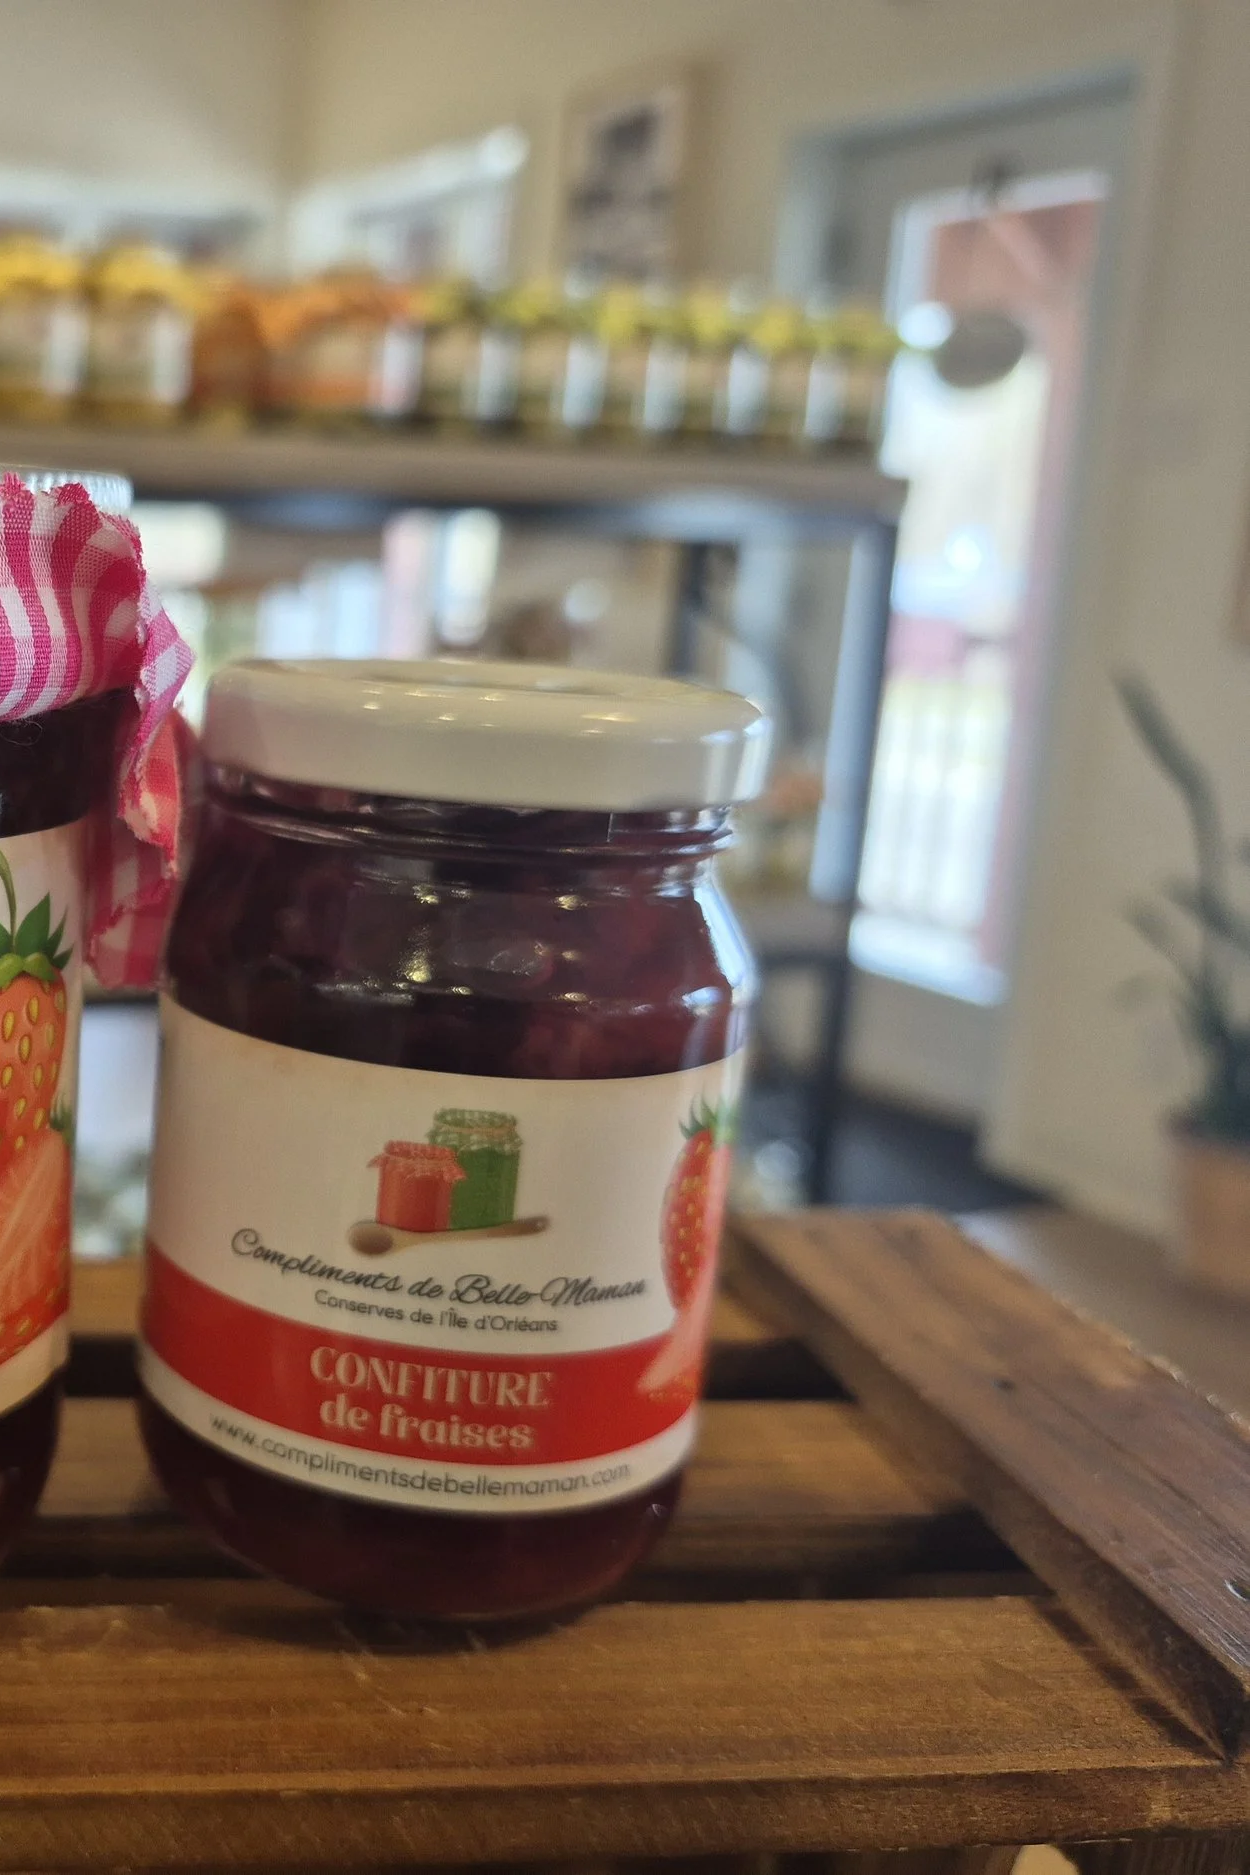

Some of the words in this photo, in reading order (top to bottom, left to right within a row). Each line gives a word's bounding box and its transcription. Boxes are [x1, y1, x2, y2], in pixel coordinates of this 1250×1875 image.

[230, 1227, 404, 1294] Compliments
[408, 1276, 444, 1299] de
[449, 1273, 648, 1307] Belle-Maman
[314, 1289, 404, 1321] Conserves
[410, 1308, 434, 1326] de
[474, 1314, 560, 1333] d'Orléans
[309, 1345, 554, 1408] CONFITURE
[318, 1393, 370, 1432] de
[377, 1402, 535, 1450] fraises
[208, 1411, 633, 1497] www.complimentsdebellemaman.com
